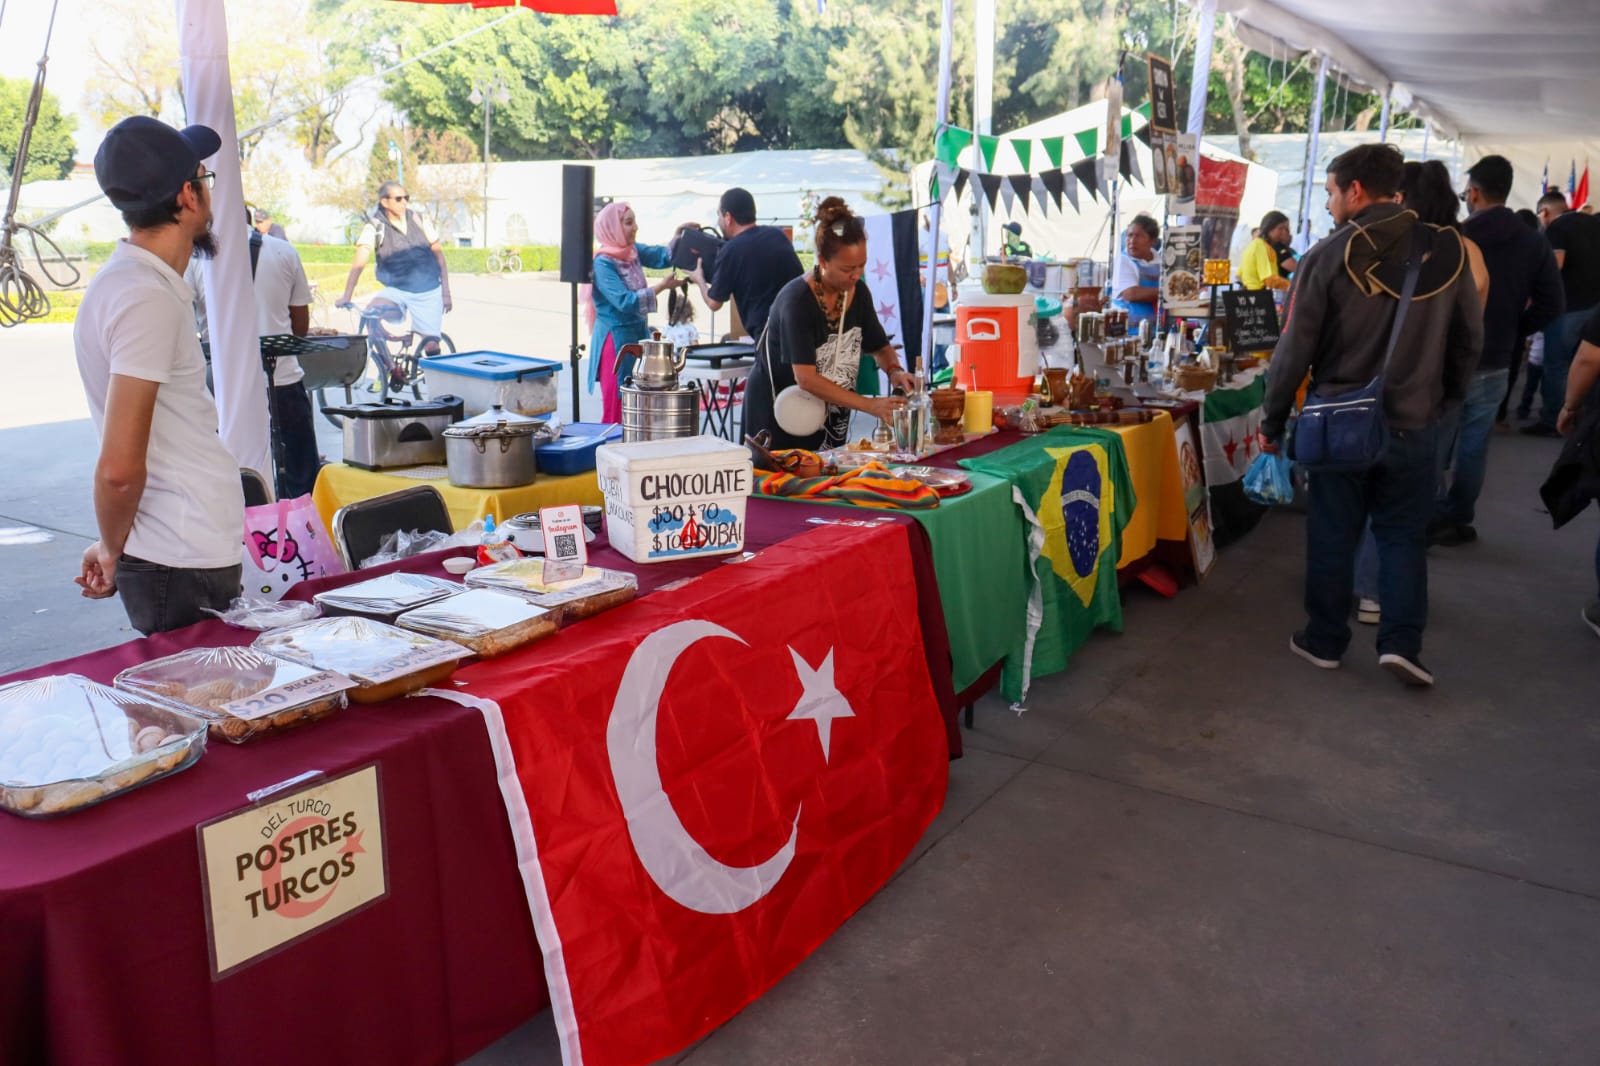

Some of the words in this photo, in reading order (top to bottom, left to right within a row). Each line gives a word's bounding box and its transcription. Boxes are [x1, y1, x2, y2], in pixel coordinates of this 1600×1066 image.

[641, 469, 746, 500] CHOCOLATE
[652, 505, 684, 530] $30
[695, 522, 742, 548] DUBAI
[228, 692, 288, 717] $20
[283, 678, 319, 691] DULCE
[260, 812, 287, 839] DEL
[288, 799, 331, 816] TURCO
[236, 811, 357, 881] POSTRES
[245, 852, 355, 918] TURCOS
